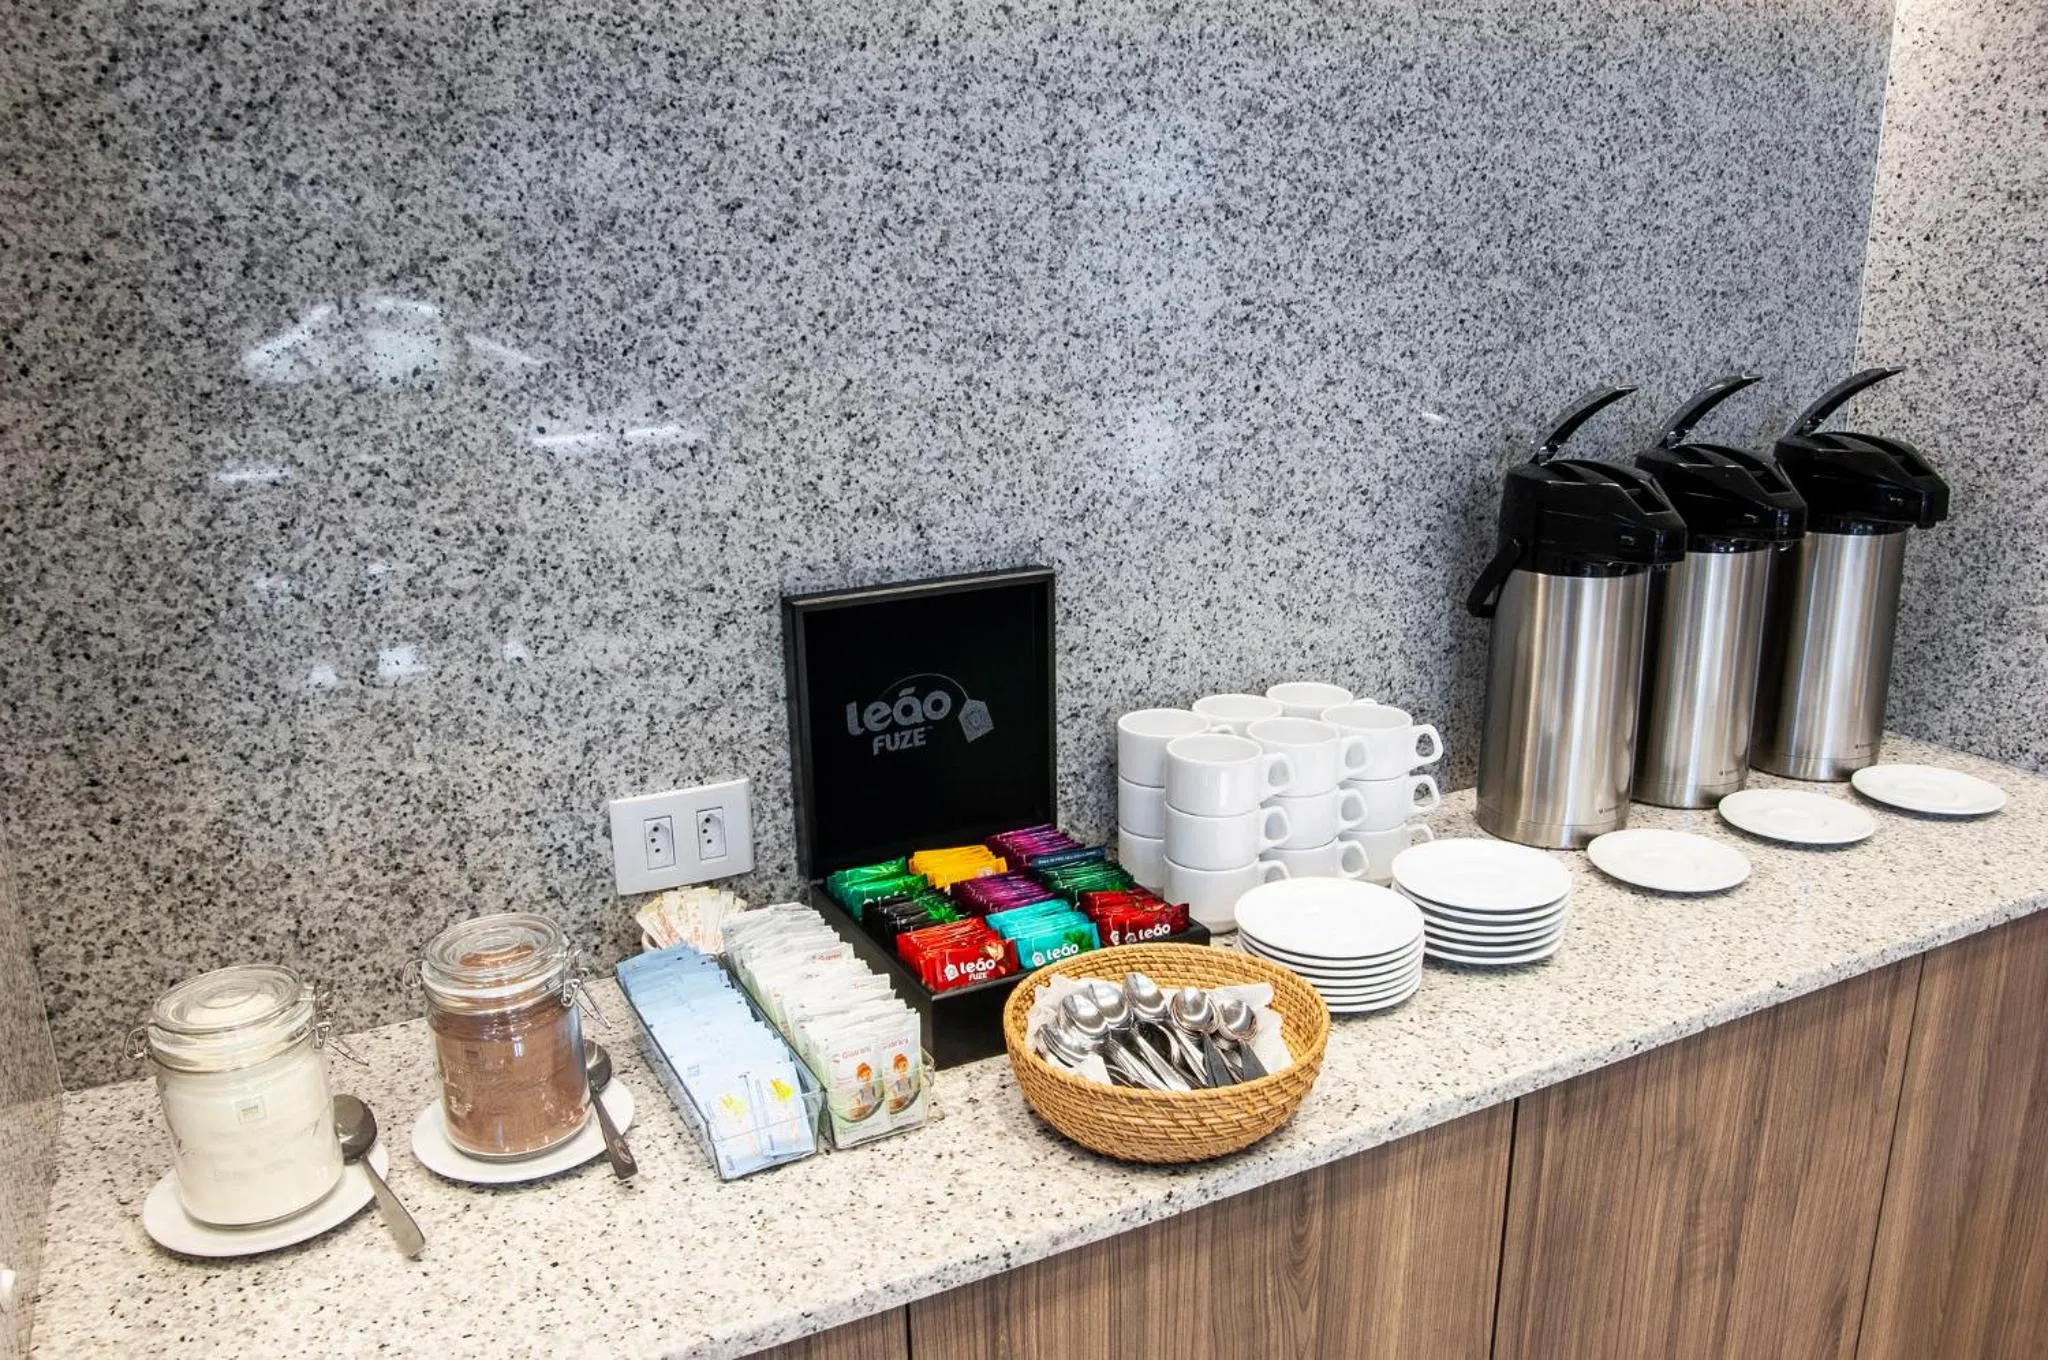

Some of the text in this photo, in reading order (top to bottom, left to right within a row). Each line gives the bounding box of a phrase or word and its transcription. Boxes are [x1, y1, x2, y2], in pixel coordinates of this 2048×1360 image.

[846, 686, 951, 736] leão
[872, 727, 926, 756] FUZE
[1138, 923, 1171, 940] leão
[1046, 943, 1079, 960] leão
[959, 957, 996, 974] leão
